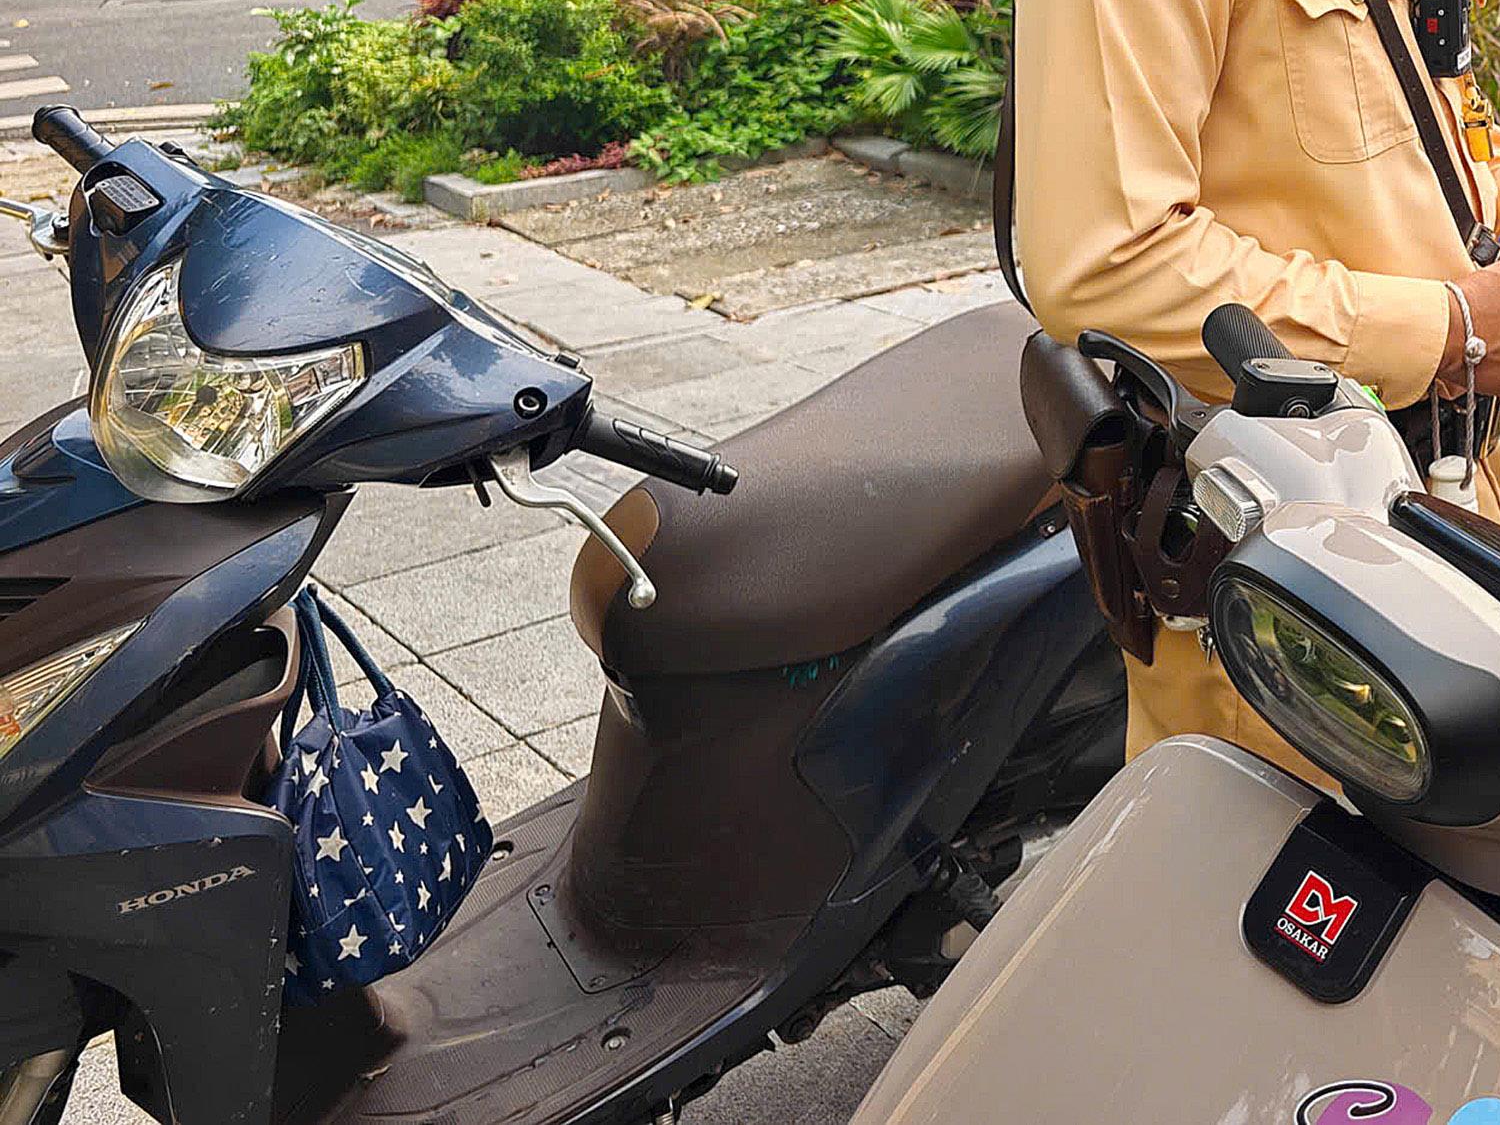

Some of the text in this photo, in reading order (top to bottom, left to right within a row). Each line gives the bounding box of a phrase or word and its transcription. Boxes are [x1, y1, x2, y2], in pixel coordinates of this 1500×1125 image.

[118, 865, 256, 914] HONDA
[1285, 871, 1358, 945] DM
[1277, 917, 1329, 961] OSAKAR
